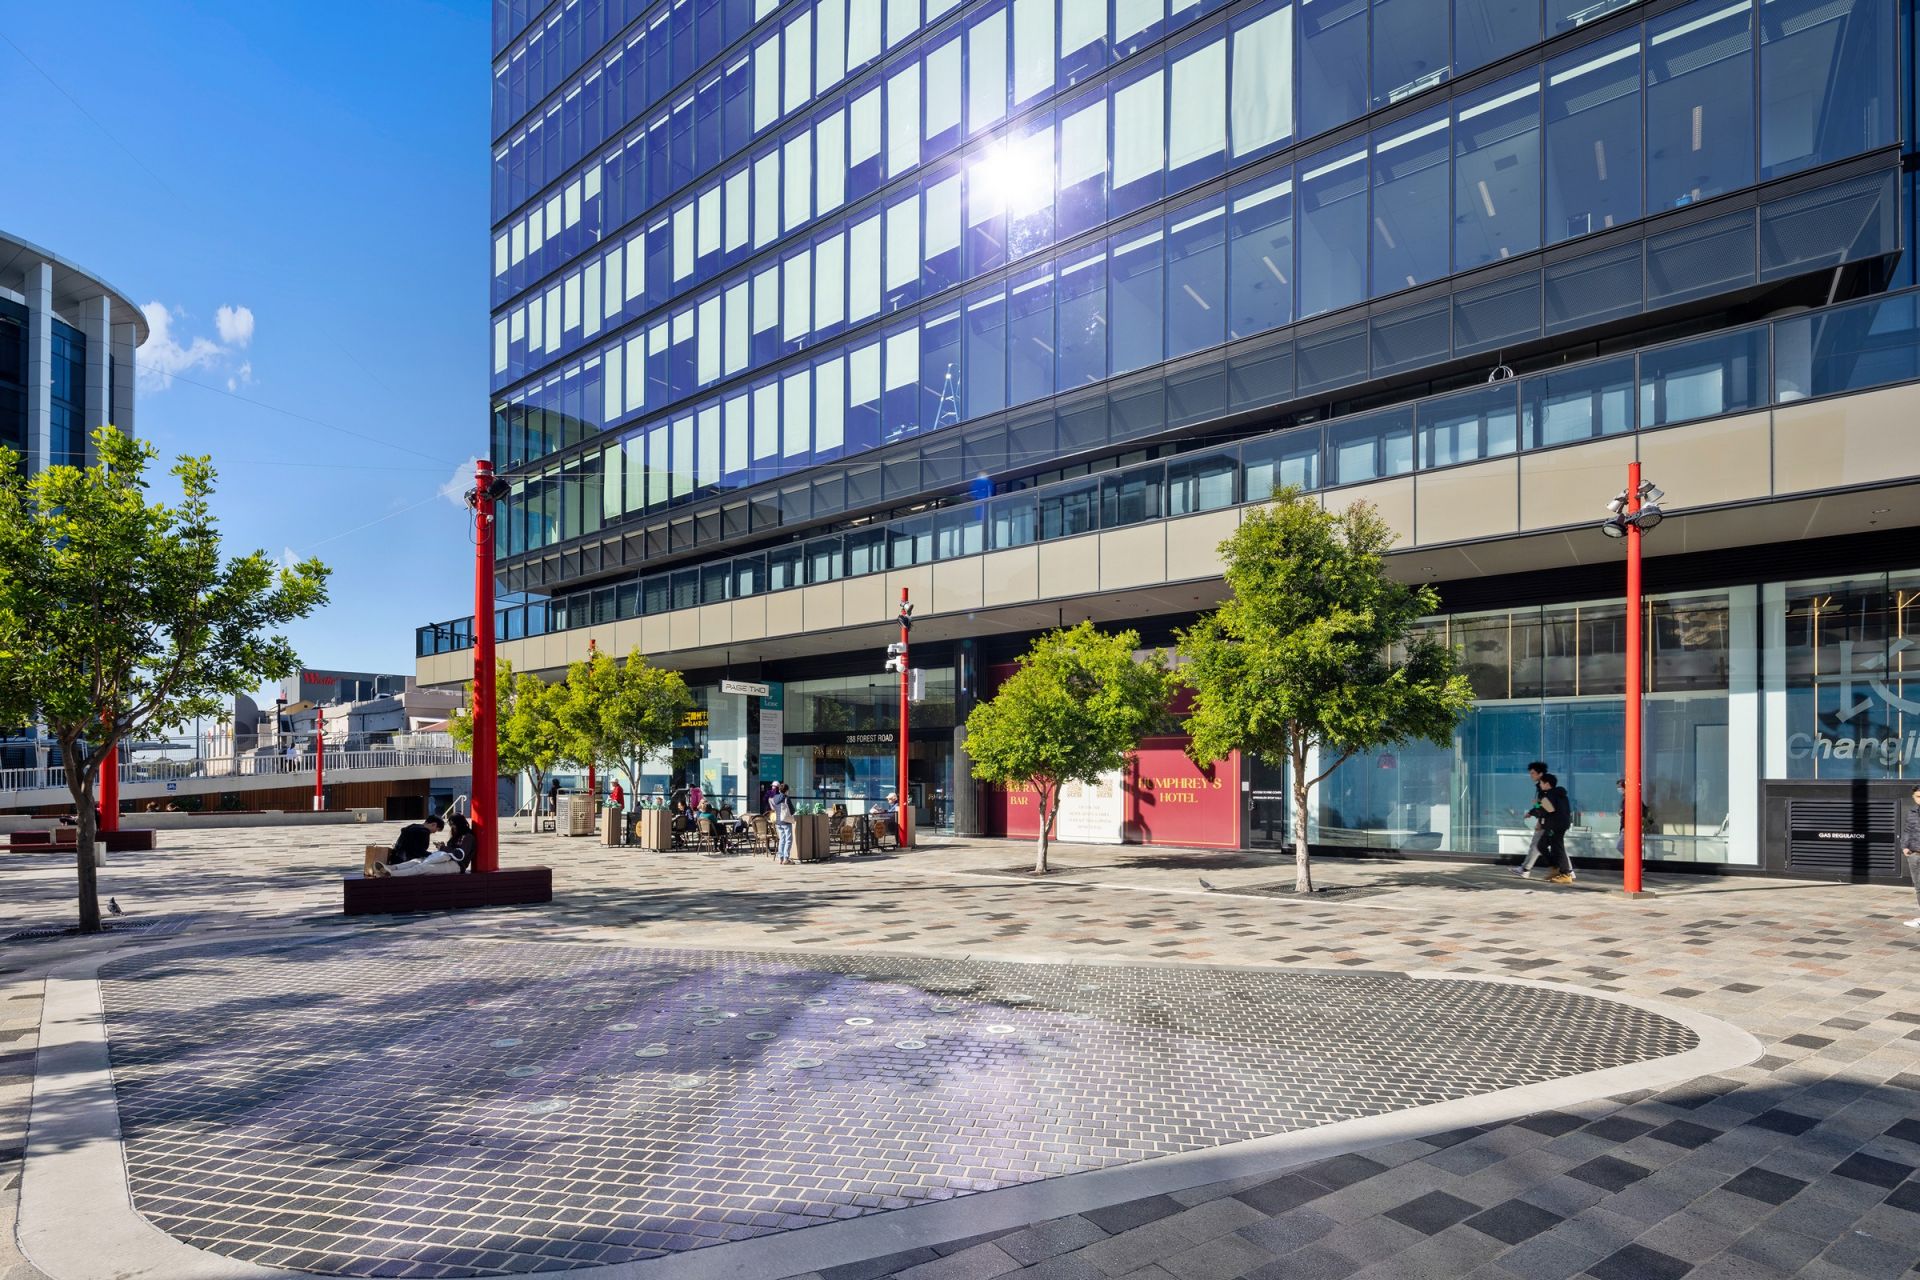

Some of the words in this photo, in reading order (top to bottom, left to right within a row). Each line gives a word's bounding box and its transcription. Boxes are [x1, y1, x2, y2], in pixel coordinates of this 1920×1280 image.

[725, 683, 748, 691] PAGE
[749, 686, 766, 694] TWO
[856, 734, 877, 743] FOREST
[877, 733, 894, 742] ROAD
[1010, 795, 1029, 805] BAR
[1160, 792, 1198, 803] HOTEL
